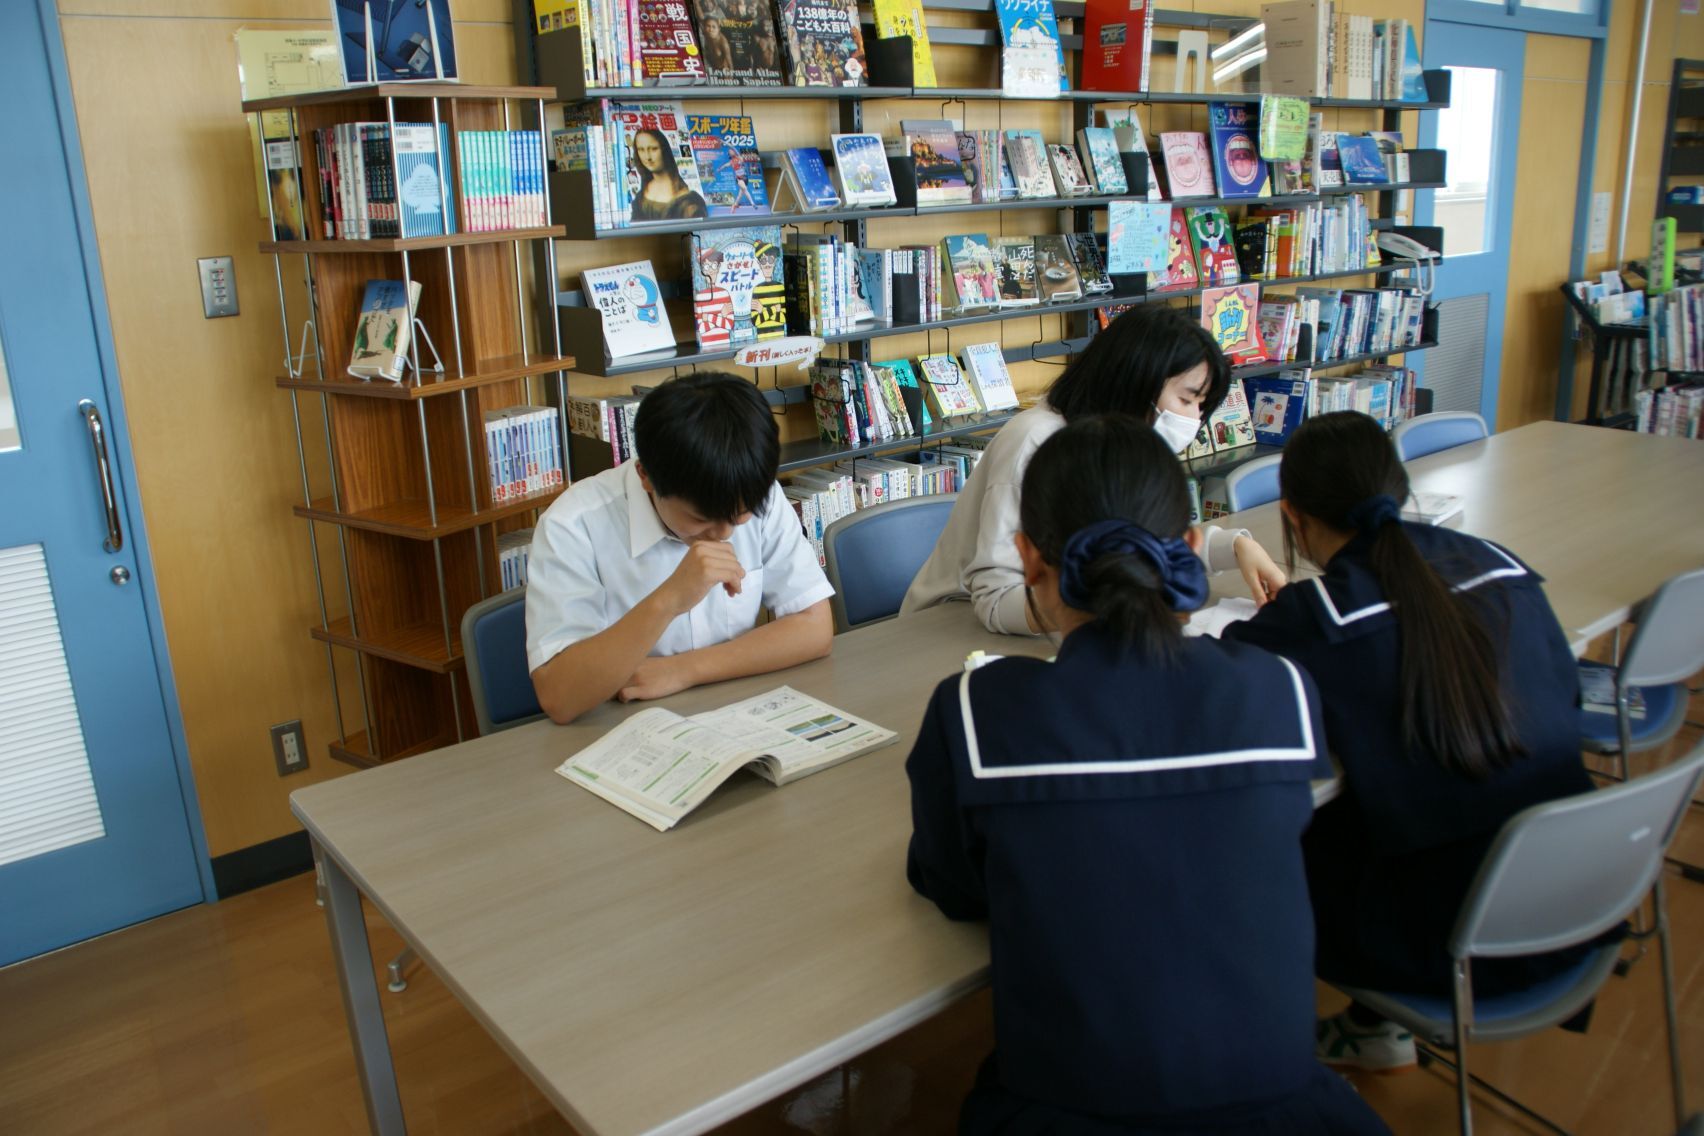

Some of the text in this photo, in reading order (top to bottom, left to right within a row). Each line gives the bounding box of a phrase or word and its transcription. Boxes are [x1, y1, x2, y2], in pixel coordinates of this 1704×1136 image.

[798, 7, 847, 20] 138億年の
[796, 20, 850, 33] こども大百科
[690, 117, 751, 135] スポーツ年鑑
[723, 135, 754, 147] 2025
[720, 268, 759, 284] スピード
[604, 304, 626, 317] ことば
